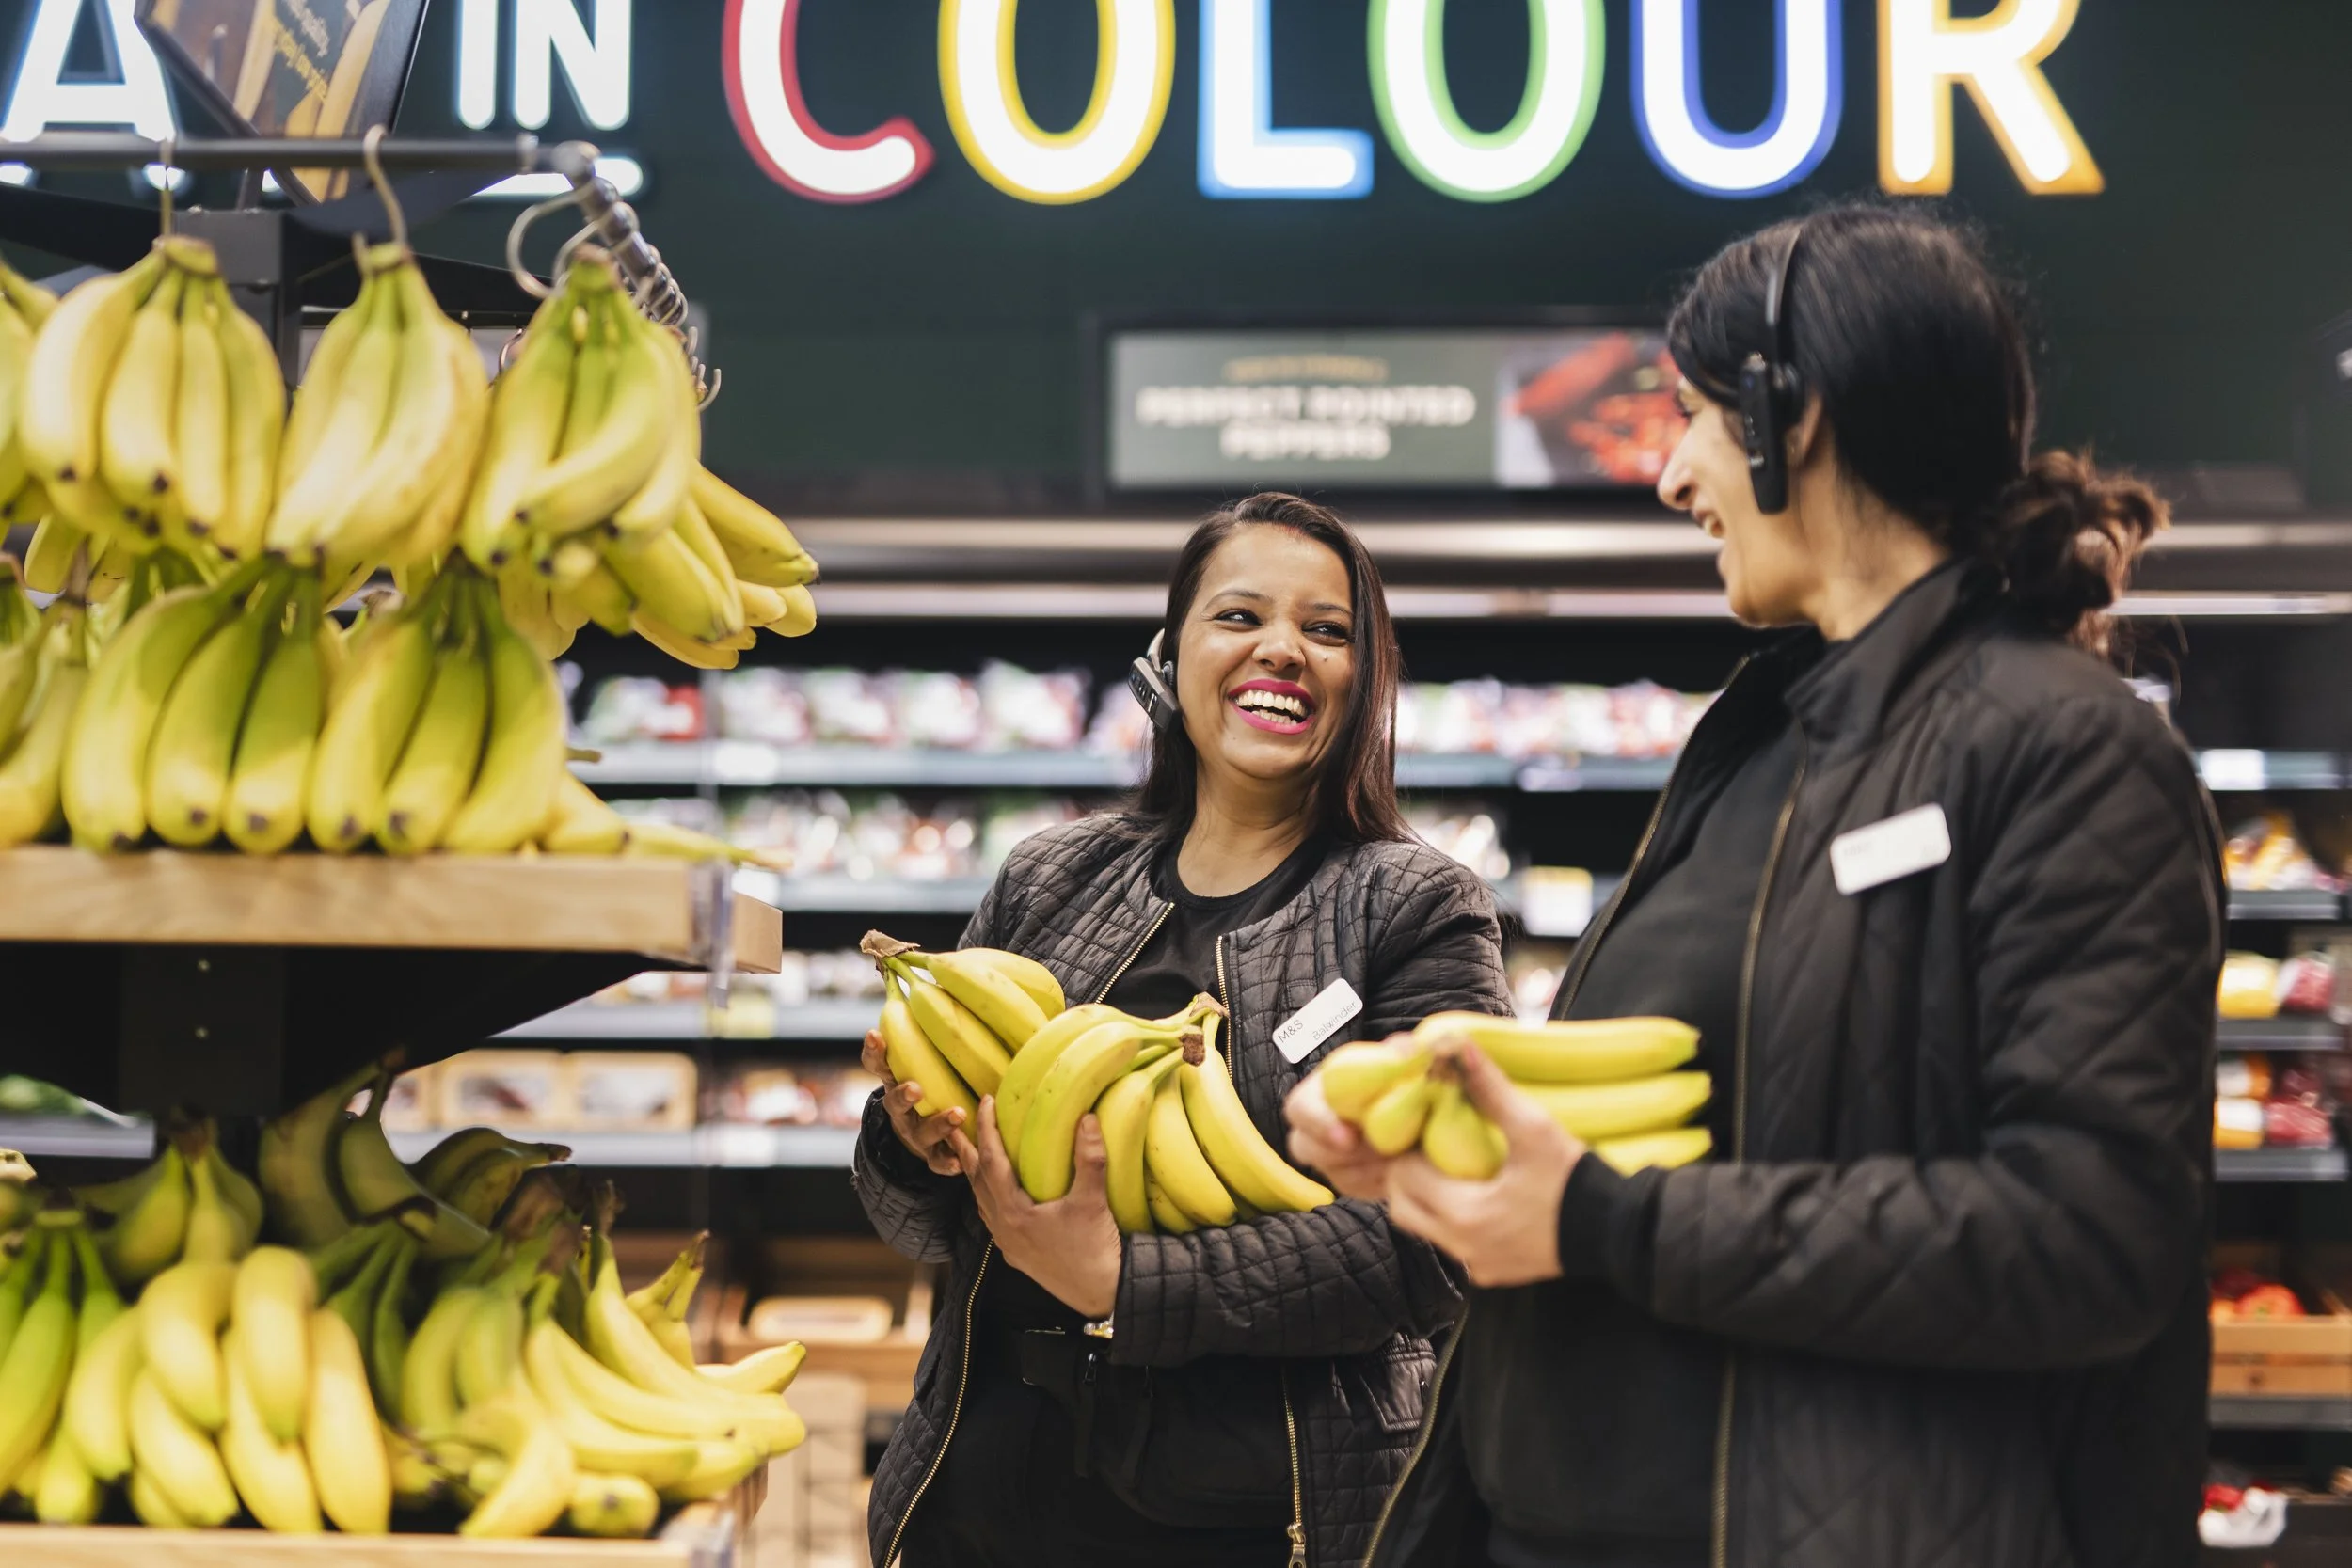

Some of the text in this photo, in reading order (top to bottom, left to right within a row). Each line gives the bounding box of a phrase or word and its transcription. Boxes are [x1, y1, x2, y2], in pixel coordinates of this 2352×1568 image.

[456, 0, 633, 130] IN
[722, 0, 2106, 205] COLOUR
[1278, 1019, 1304, 1043] M&S
[1312, 1000, 1357, 1041] Balwinder
